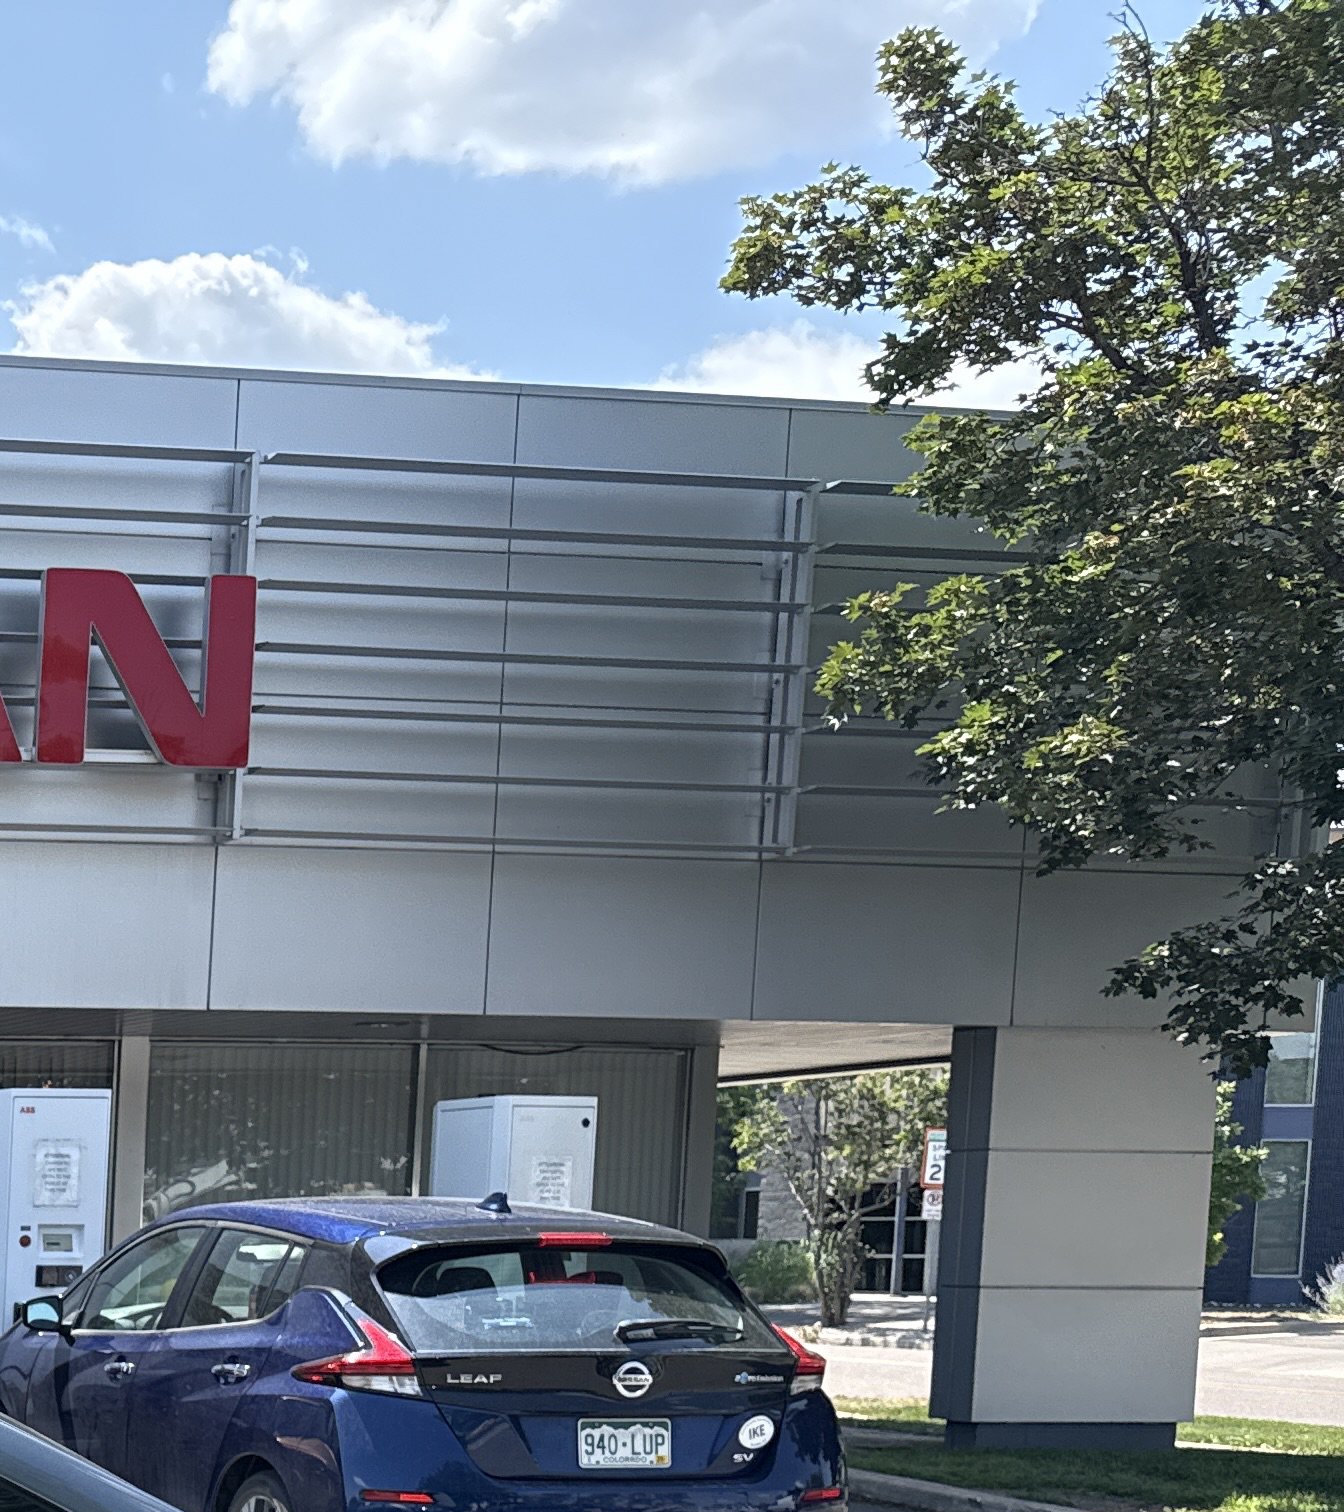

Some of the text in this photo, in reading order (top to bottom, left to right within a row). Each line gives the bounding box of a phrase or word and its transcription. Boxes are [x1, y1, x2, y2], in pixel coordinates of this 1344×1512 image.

[446, 1373, 502, 1384] LEAF
[748, 1423, 766, 1441] IKE
[602, 1455, 647, 1464] COLORADO
[733, 1452, 754, 1463] SV
